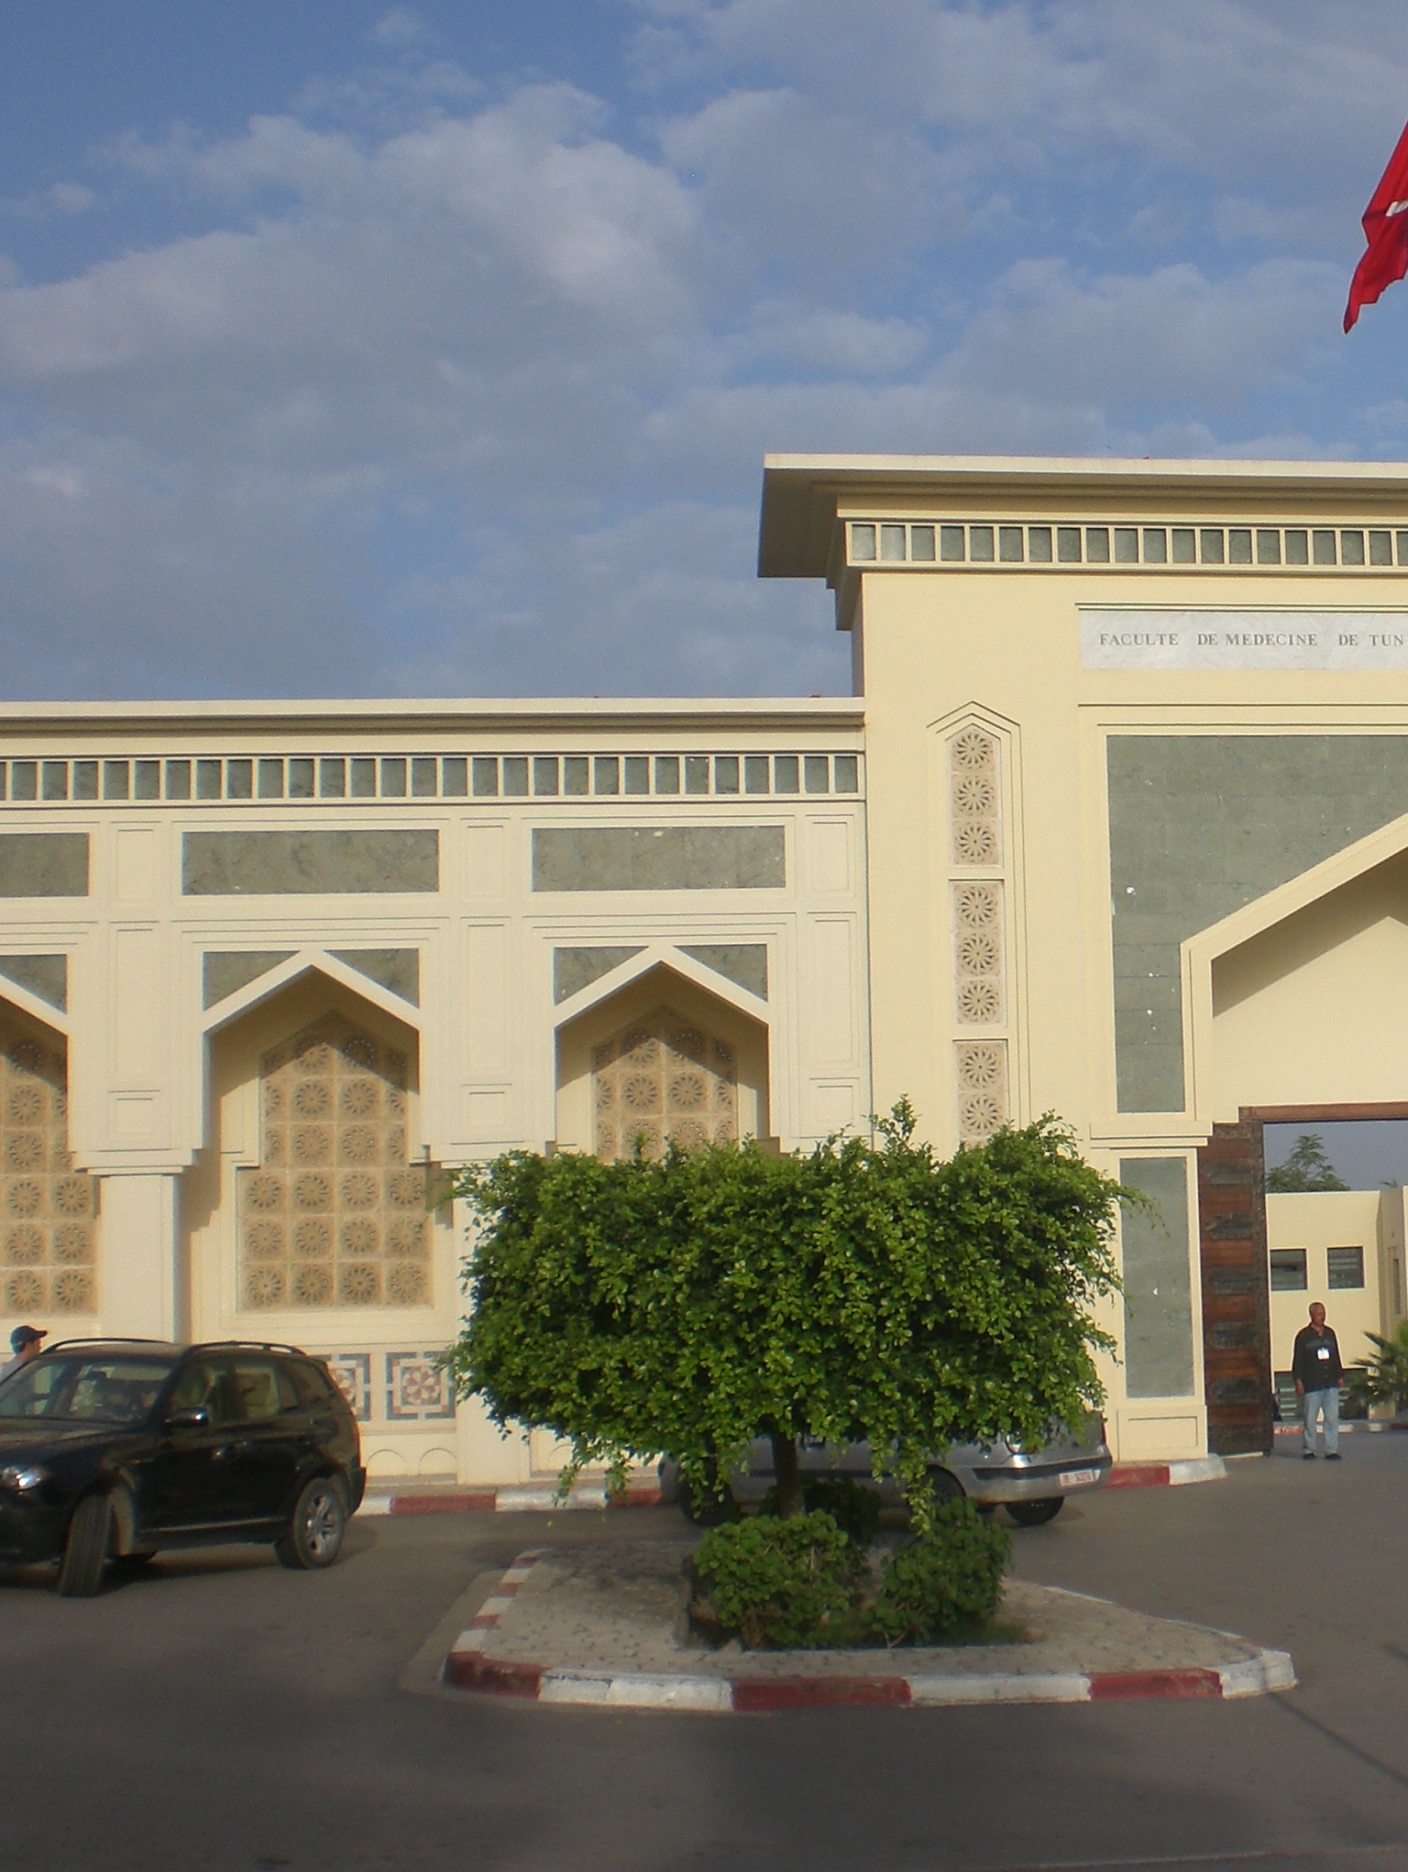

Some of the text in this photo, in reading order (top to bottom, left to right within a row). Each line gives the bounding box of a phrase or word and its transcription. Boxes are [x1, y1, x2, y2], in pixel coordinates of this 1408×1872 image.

[1099, 633, 1179, 646] FACULTE
[1197, 633, 1218, 646] DE
[1225, 633, 1318, 646] MEDECINE
[1338, 633, 1359, 647] DE
